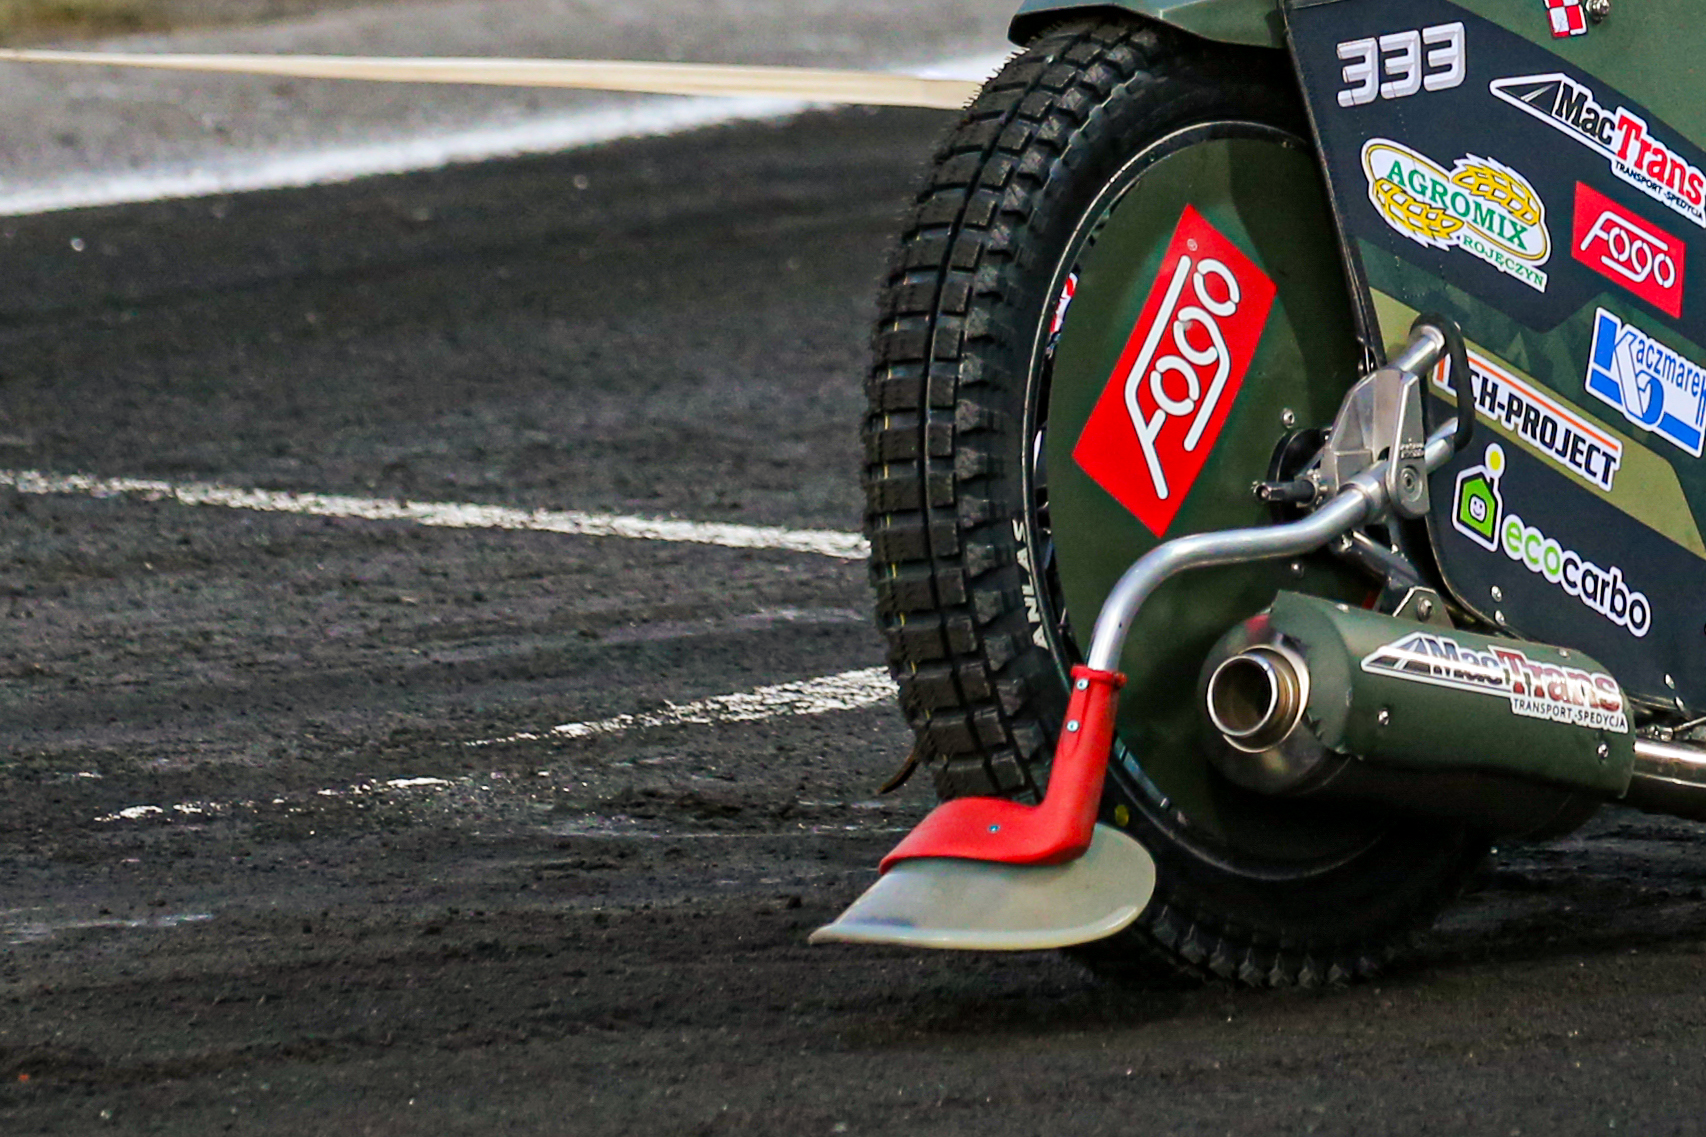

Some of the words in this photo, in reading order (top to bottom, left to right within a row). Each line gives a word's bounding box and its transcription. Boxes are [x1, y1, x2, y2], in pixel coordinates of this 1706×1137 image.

[1336, 22, 1466, 107] 333
[1387, 160, 1529, 251] AGROMIX
[1614, 161, 1663, 194] TRANSPORT
[1011, 519, 1050, 651] ANLAS
[1505, 521, 1648, 630] ecocarbo
[1513, 697, 1572, 720] TRANSPORT
